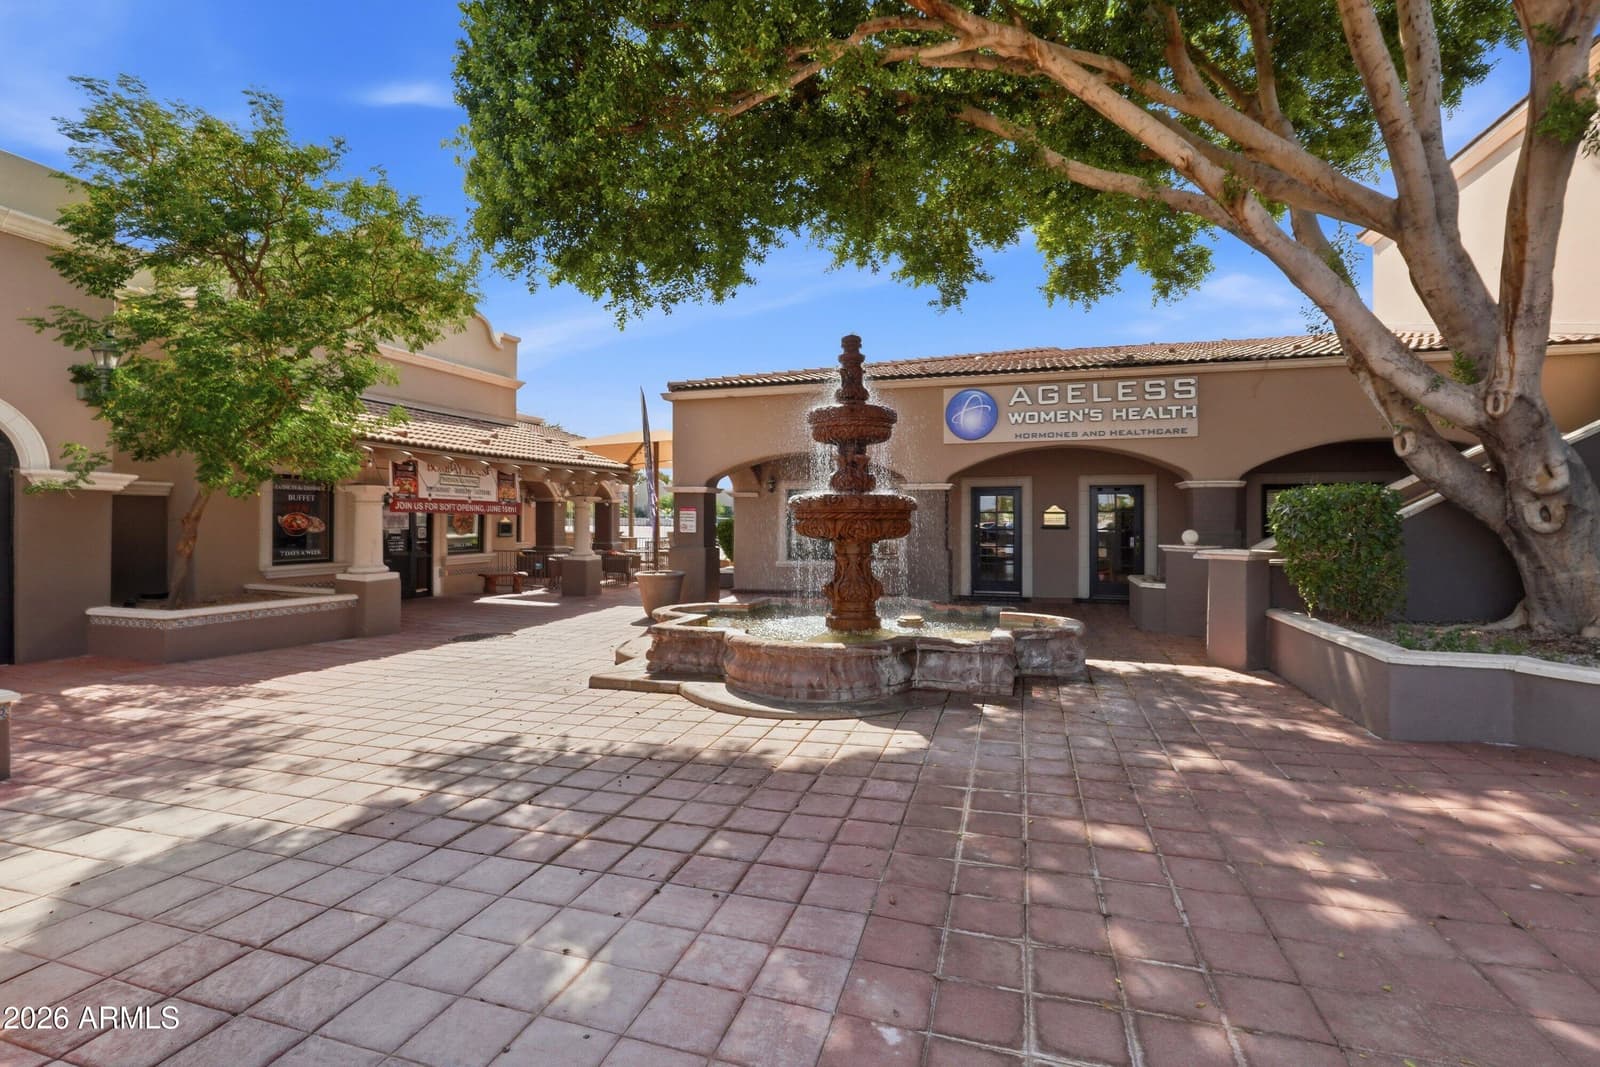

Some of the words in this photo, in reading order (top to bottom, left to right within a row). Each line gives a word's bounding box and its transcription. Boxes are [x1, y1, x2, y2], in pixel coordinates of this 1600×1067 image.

[1008, 377, 1198, 406] AGELESS
[1008, 408, 1103, 425] WOMEN'S
[1112, 405, 1198, 421] HEALTH
[1014, 430, 1079, 440] HORMONES
[1082, 429, 1106, 438] AND
[1109, 427, 1188, 436] HEALTHCARE
[288, 494, 316, 502] BUFFET
[394, 501, 413, 510] JOIN
[413, 502, 424, 511] US
[425, 502, 439, 511] FOR
[439, 503, 457, 512] SOFT
[487, 505, 502, 513] JUNE
